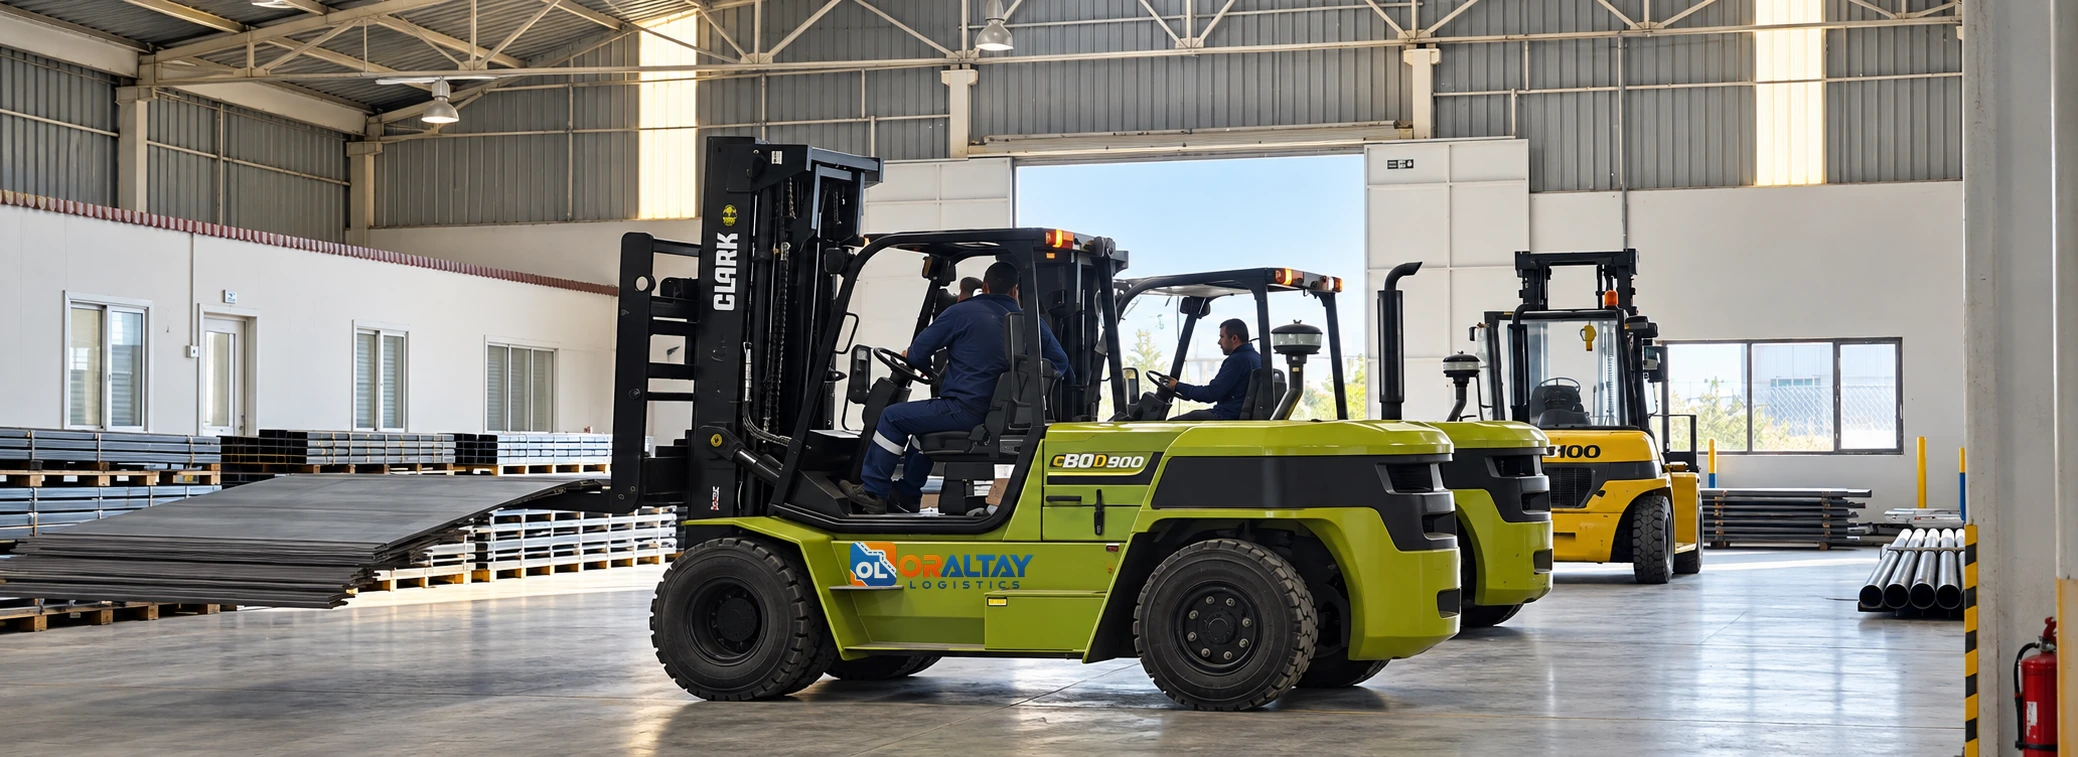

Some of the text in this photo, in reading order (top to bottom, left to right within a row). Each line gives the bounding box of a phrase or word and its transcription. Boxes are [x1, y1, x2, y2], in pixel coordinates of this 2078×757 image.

[714, 233, 738, 311] CLARK
[855, 562, 888, 579] OL
[898, 554, 1034, 578] ORALTAY
[909, 581, 1020, 590] LOGISTICS
